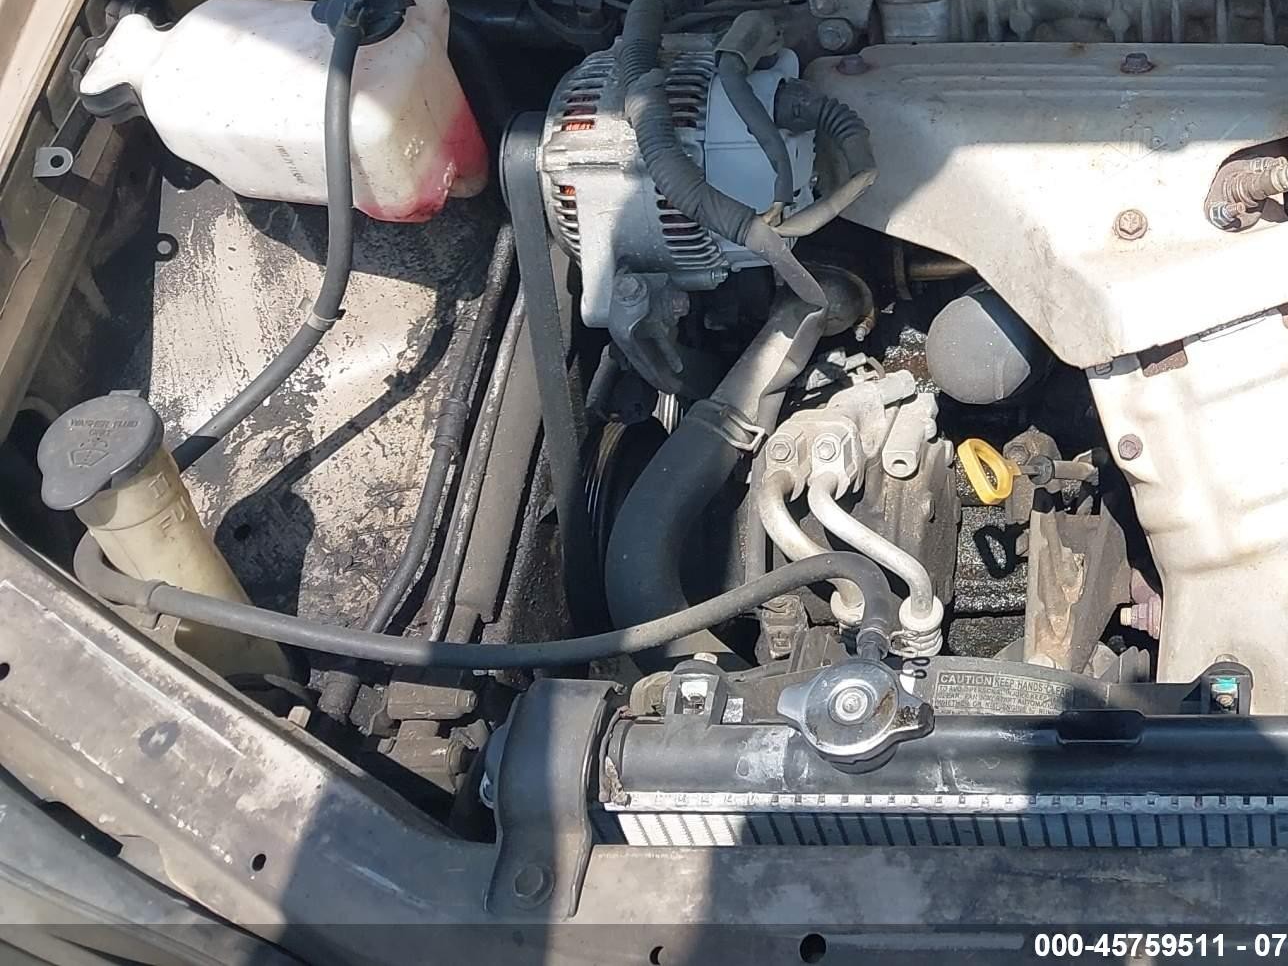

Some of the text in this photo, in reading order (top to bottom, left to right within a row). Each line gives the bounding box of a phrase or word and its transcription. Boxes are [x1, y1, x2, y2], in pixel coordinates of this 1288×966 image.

[940, 674, 1071, 698] CAUTION KEEP HANDS CLEAR
